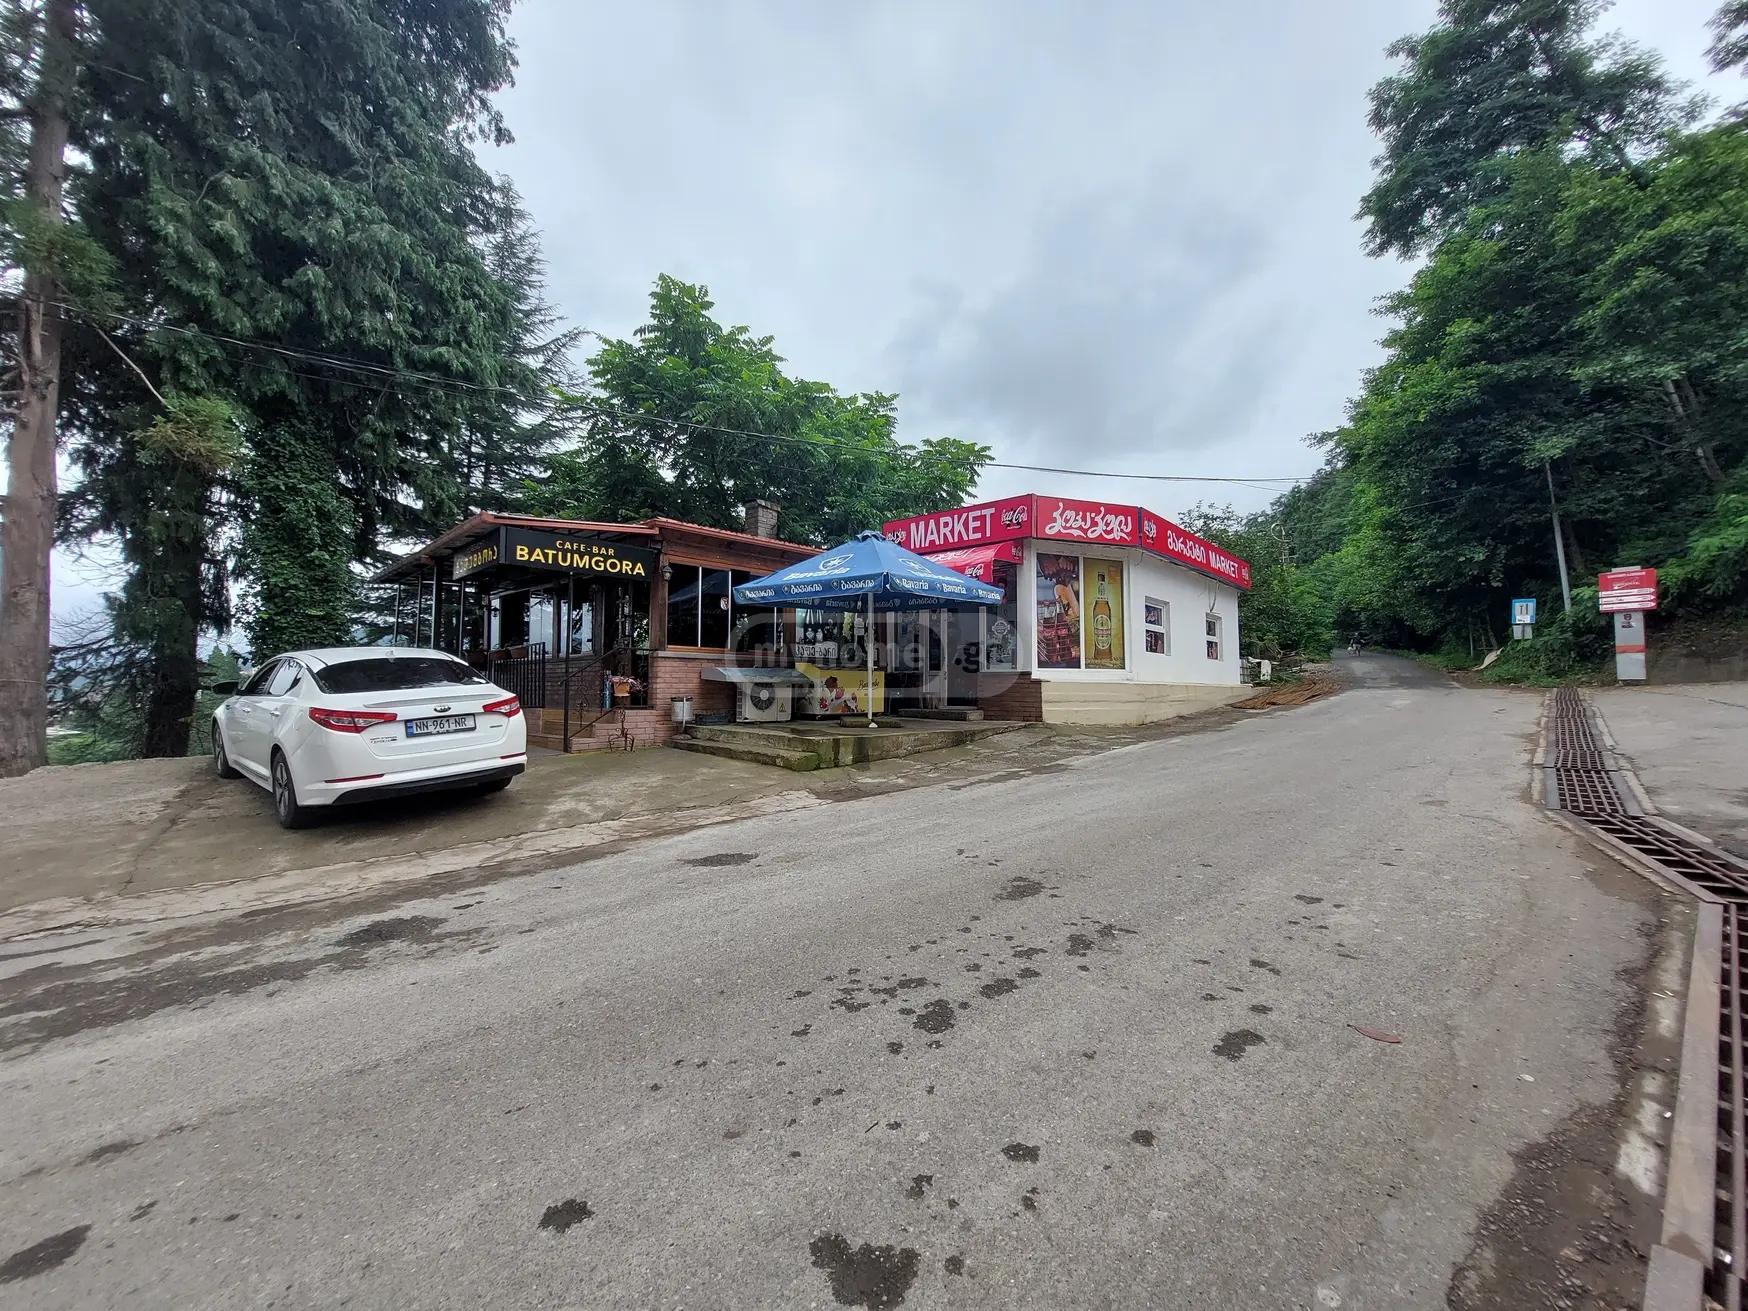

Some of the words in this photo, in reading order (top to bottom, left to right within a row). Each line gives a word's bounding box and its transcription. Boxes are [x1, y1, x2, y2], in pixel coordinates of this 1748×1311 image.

[910, 508, 995, 549] MARKET
[516, 545, 645, 576] BATUMGORA
[556, 540, 615, 556] CAFE-BAR
[1209, 550, 1238, 578] MARKET
[902, 578, 929, 590] Bavaria
[943, 584, 967, 594] Bavaria
[978, 589, 1001, 600] Bavaria
[415, 717, 467, 732] NN-961-NR
